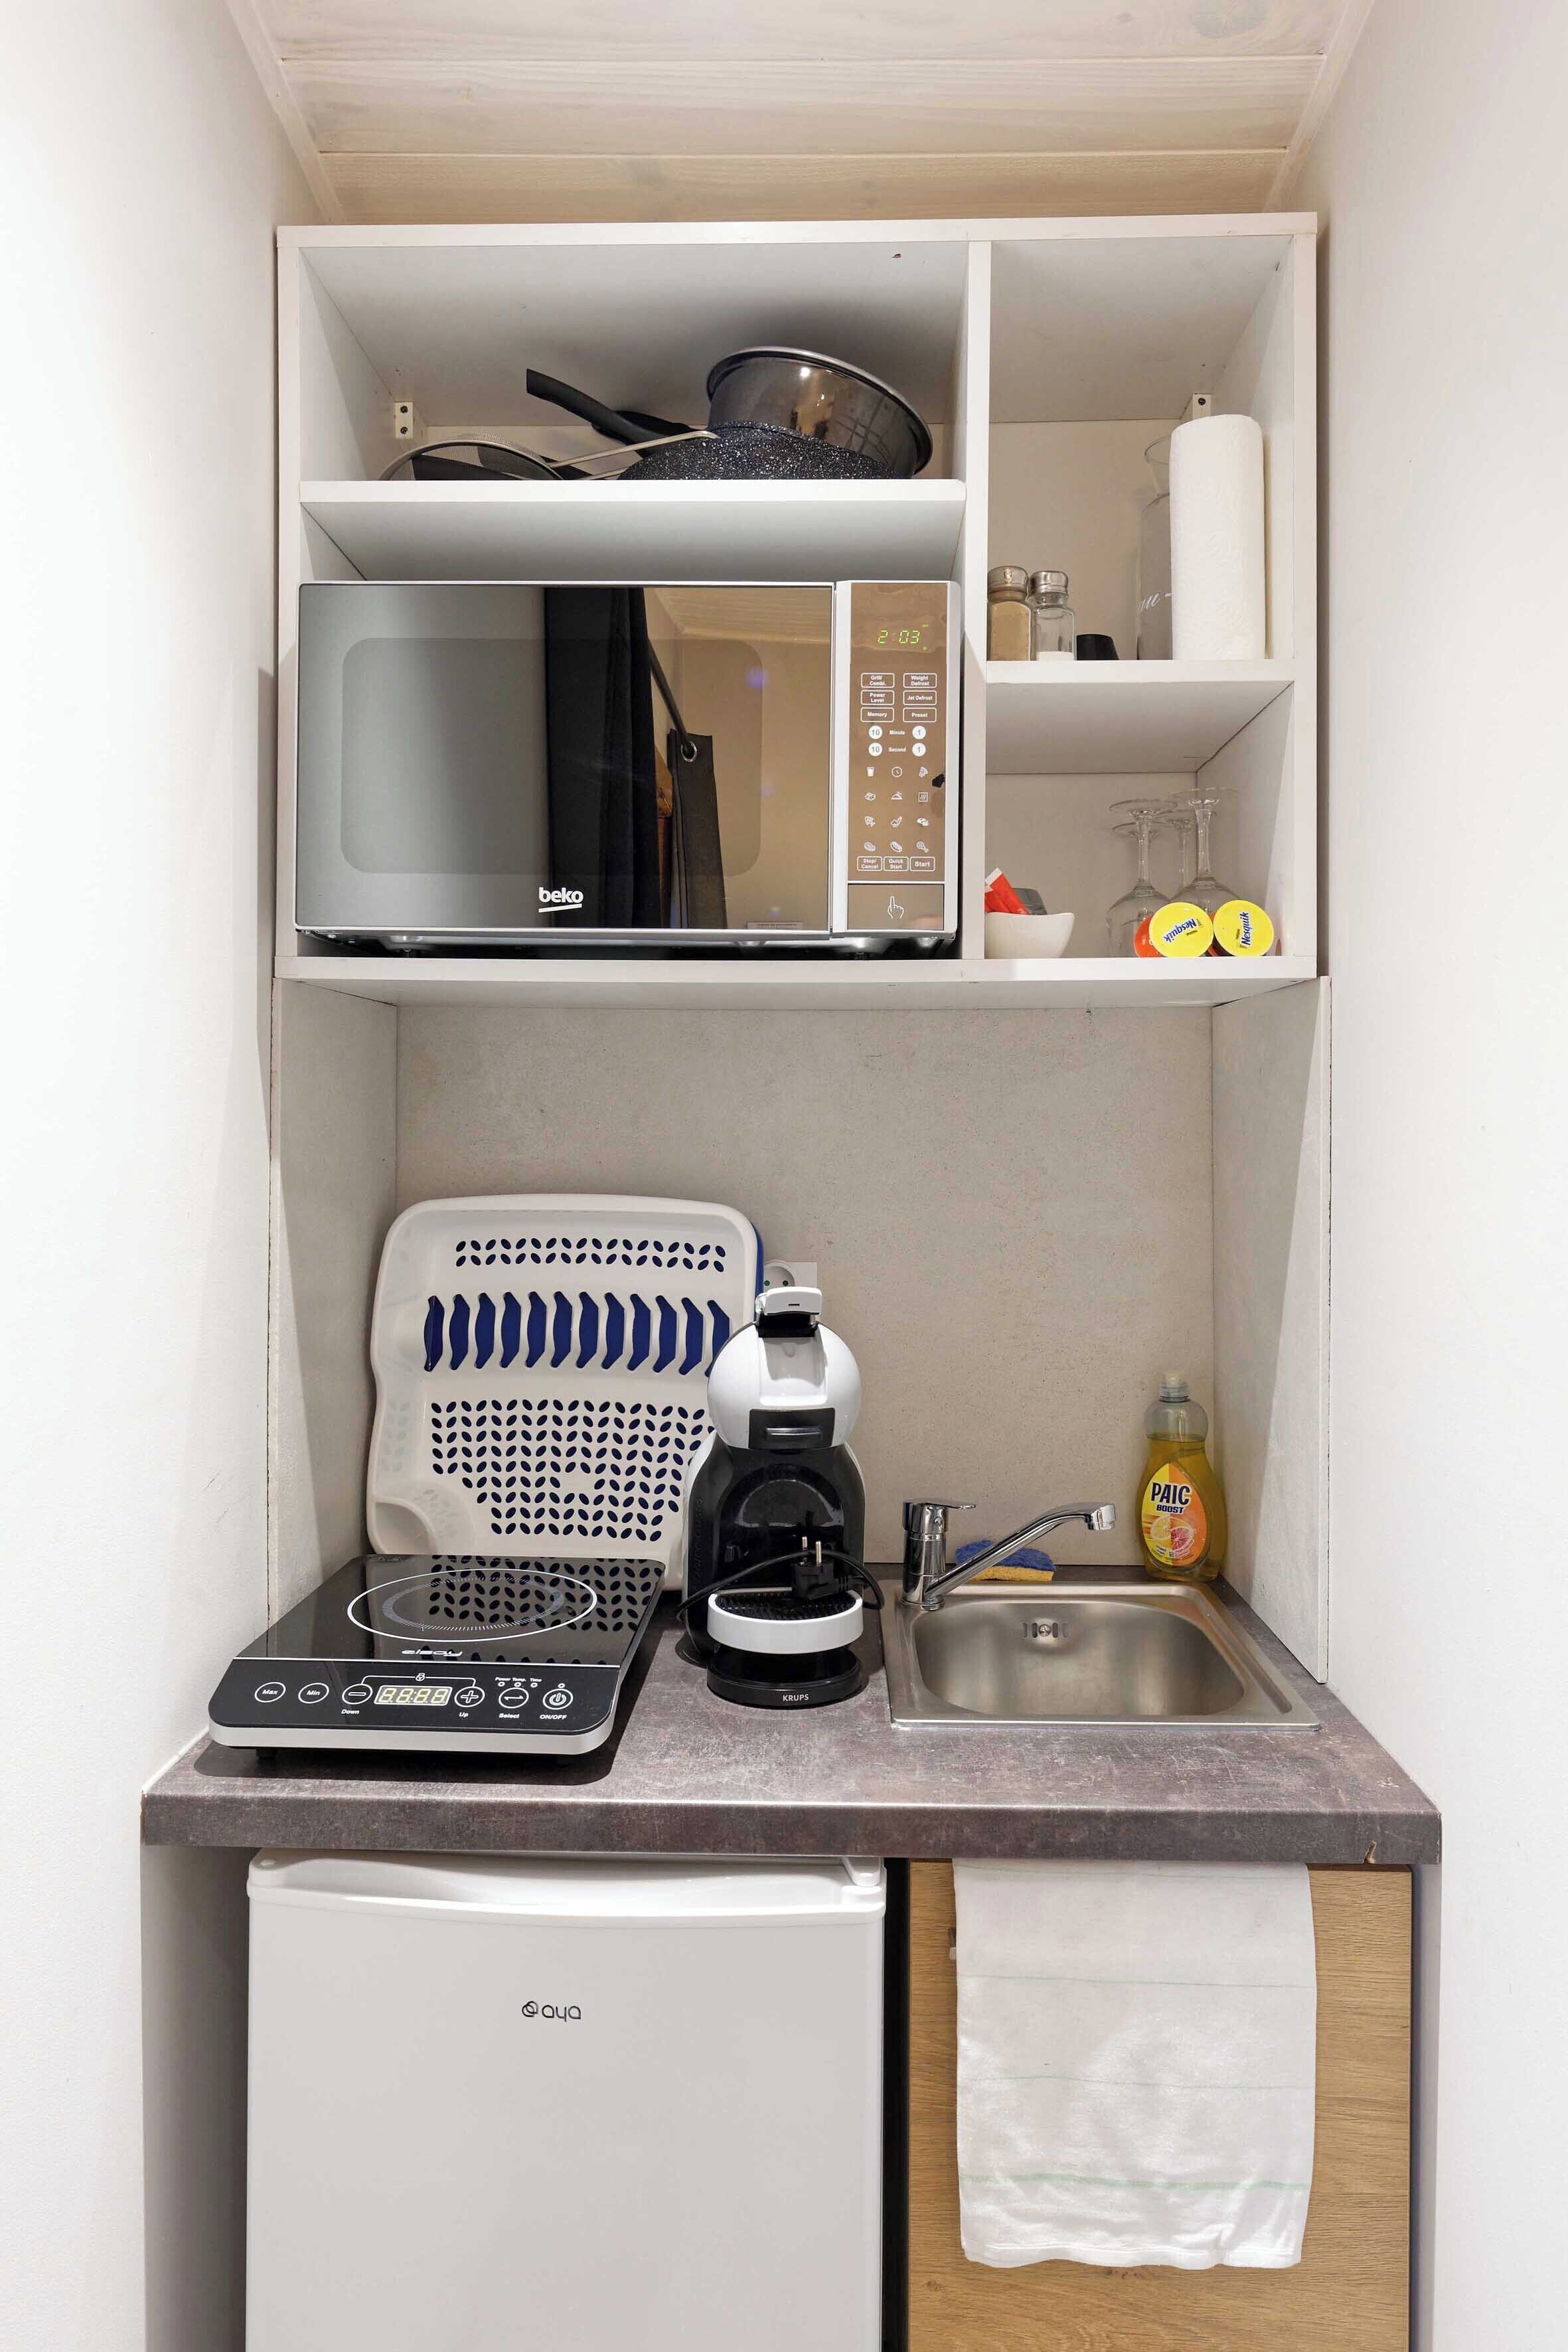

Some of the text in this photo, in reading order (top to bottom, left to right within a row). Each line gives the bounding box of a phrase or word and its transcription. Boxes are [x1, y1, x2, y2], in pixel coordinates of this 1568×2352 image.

[538, 887, 584, 903] beko
[1164, 918, 1197, 943] Nesquik
[1239, 911, 1253, 945] Nesquik
[1150, 1482, 1190, 1506] PAIC
[1156, 1504, 1185, 1514] BOOST
[541, 2005, 582, 2022] aya
